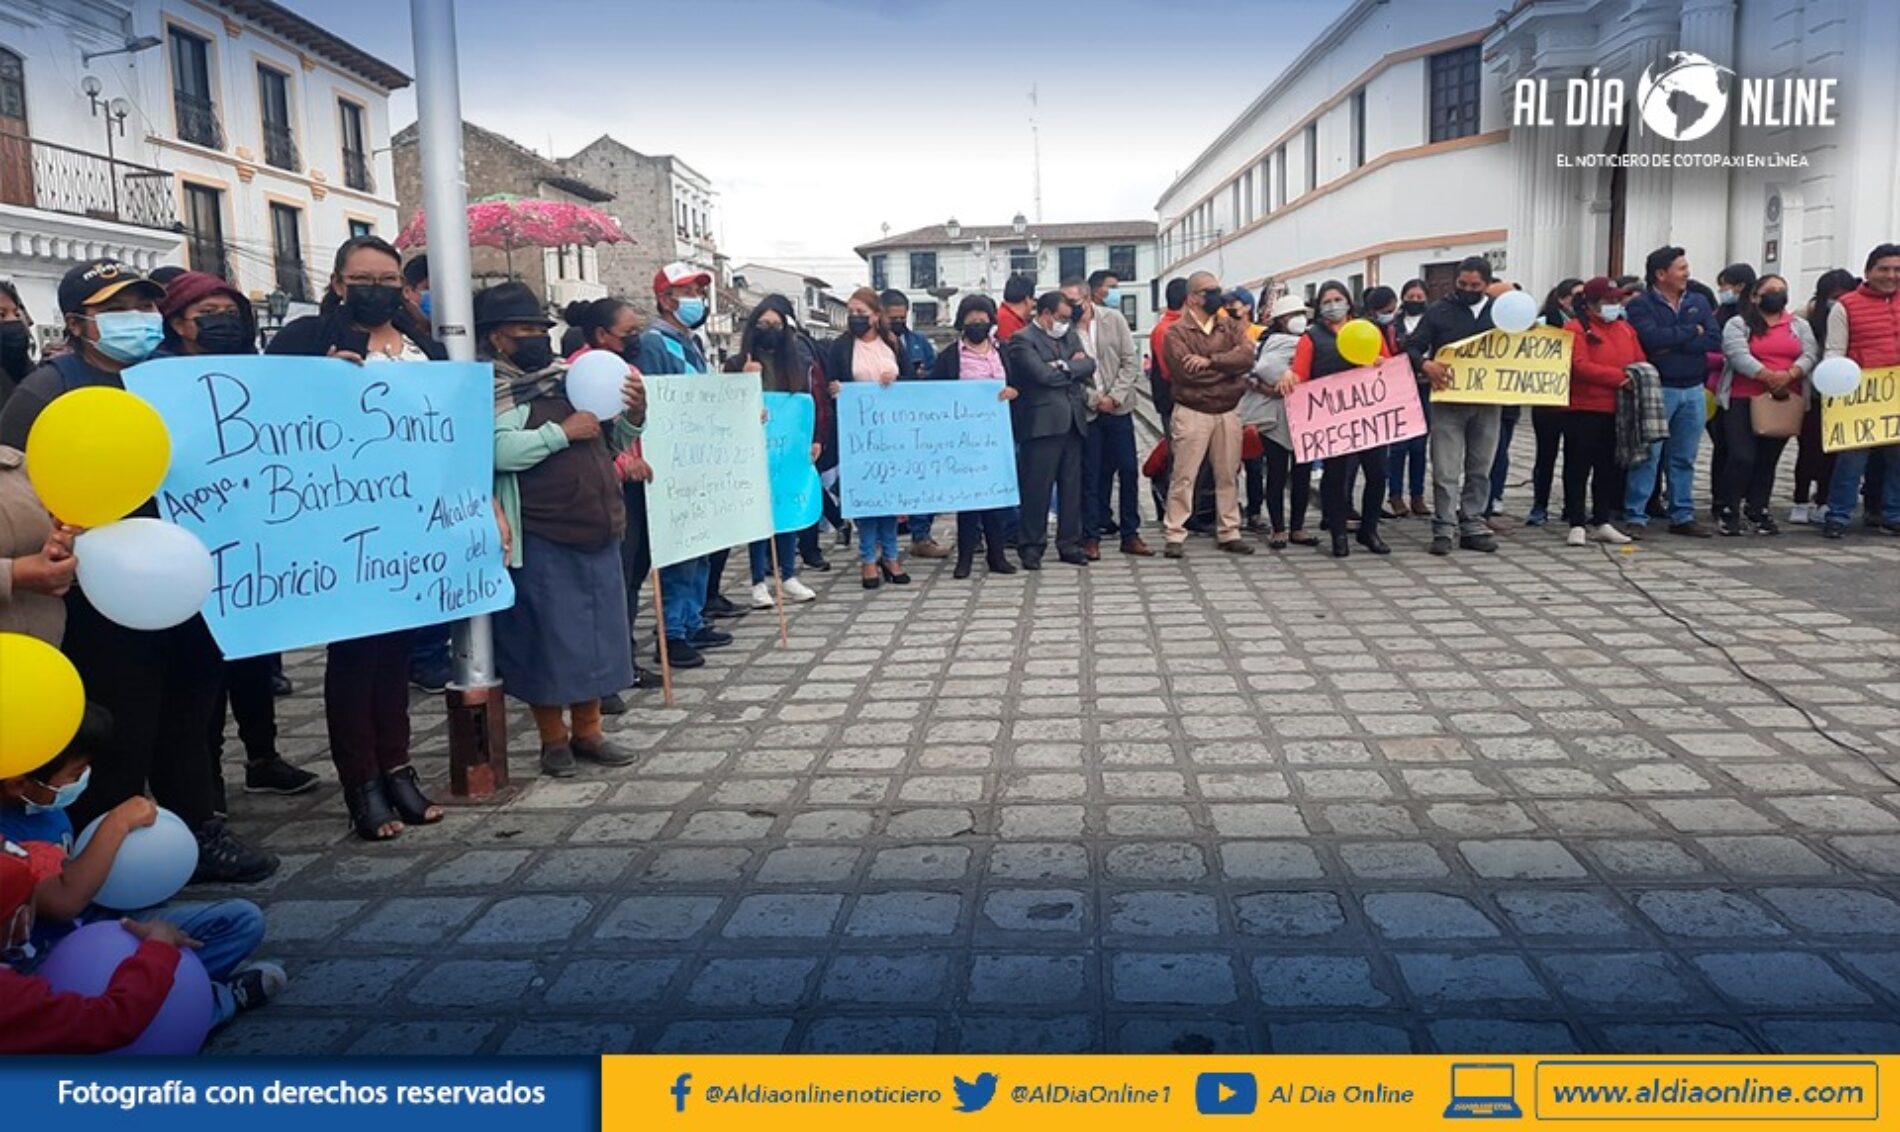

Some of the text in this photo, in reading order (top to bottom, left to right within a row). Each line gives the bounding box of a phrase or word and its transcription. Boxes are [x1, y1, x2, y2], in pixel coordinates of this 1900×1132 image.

[1515, 335, 1563, 360] APOYA
[1307, 370, 1387, 422] MULALÓ
[1466, 367, 1488, 391] DR
[353, 381, 456, 460] Santa
[1301, 406, 1408, 462] PRESENTE
[1853, 417, 1877, 444] DR
[465, 533, 488, 562] del
[210, 525, 448, 618] Fabricio Tinajero
